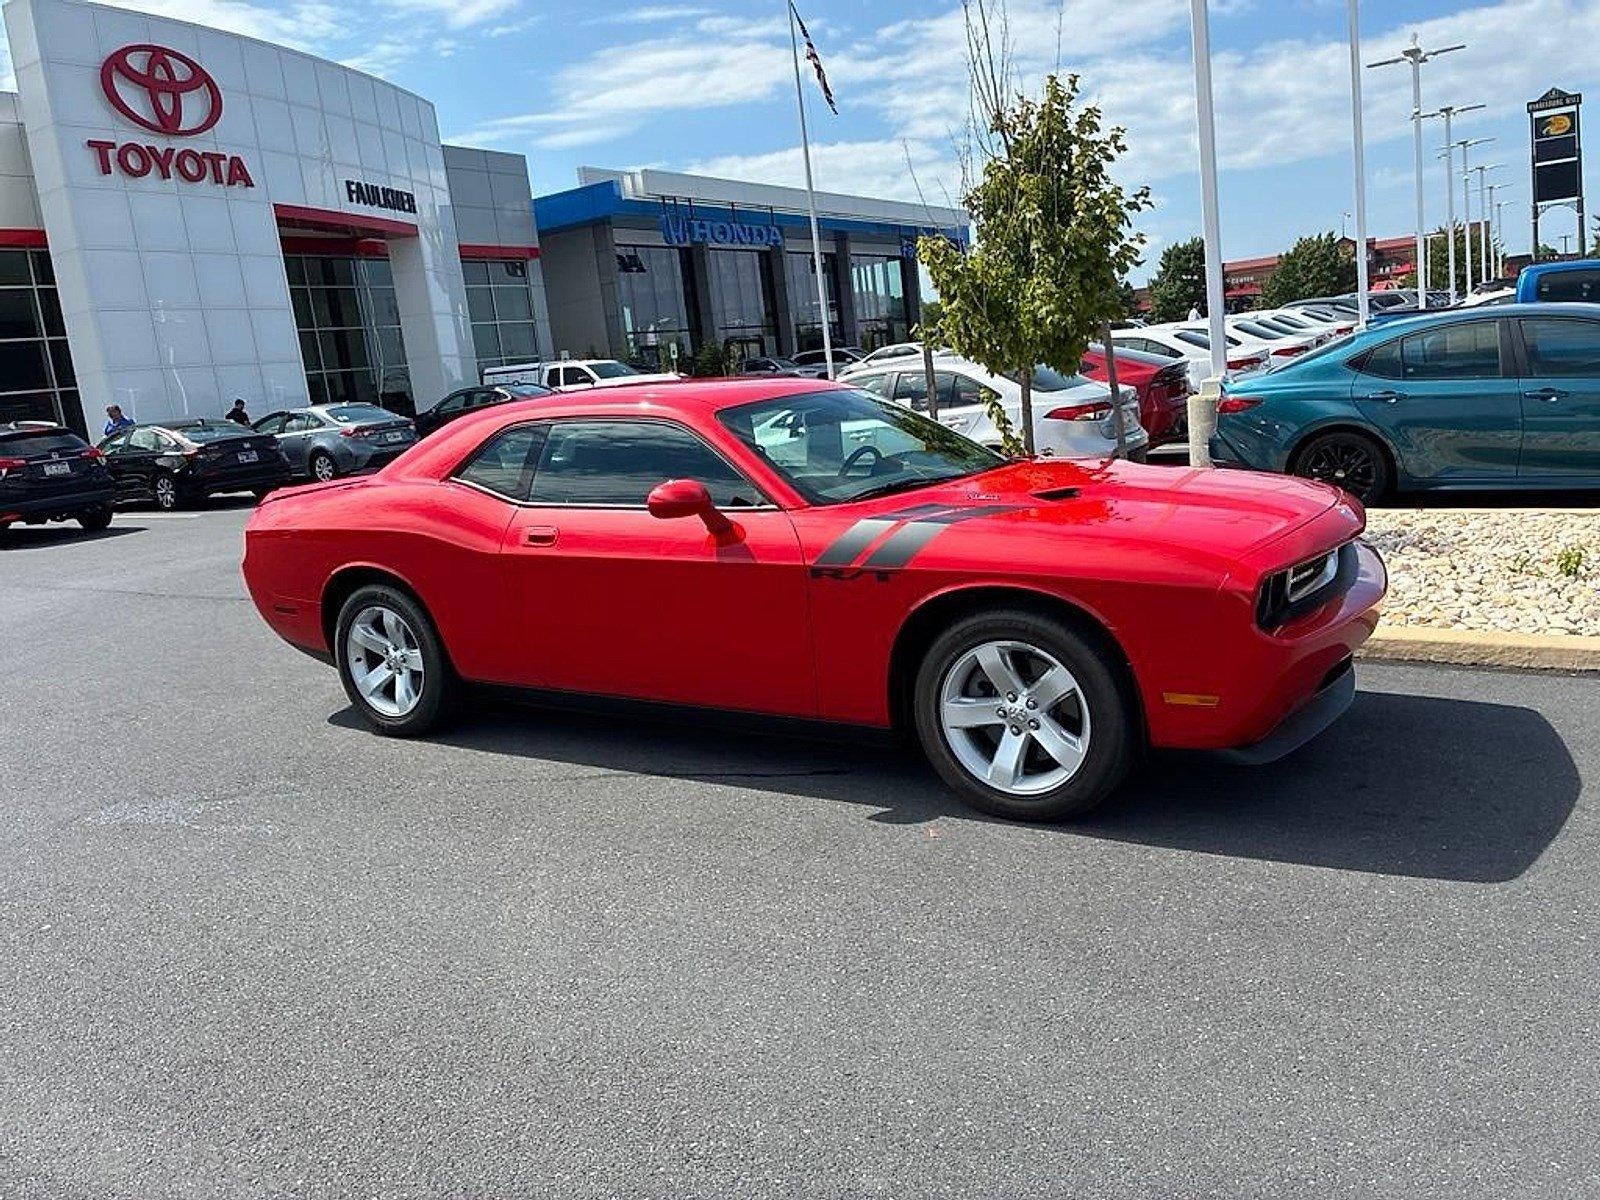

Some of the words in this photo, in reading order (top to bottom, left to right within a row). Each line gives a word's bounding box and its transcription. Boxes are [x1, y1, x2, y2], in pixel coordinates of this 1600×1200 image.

[88, 140, 254, 187] TOYOTA
[345, 180, 417, 213] FAULKNER
[691, 220, 785, 246] HONDA
[811, 567, 898, 583] R/T
